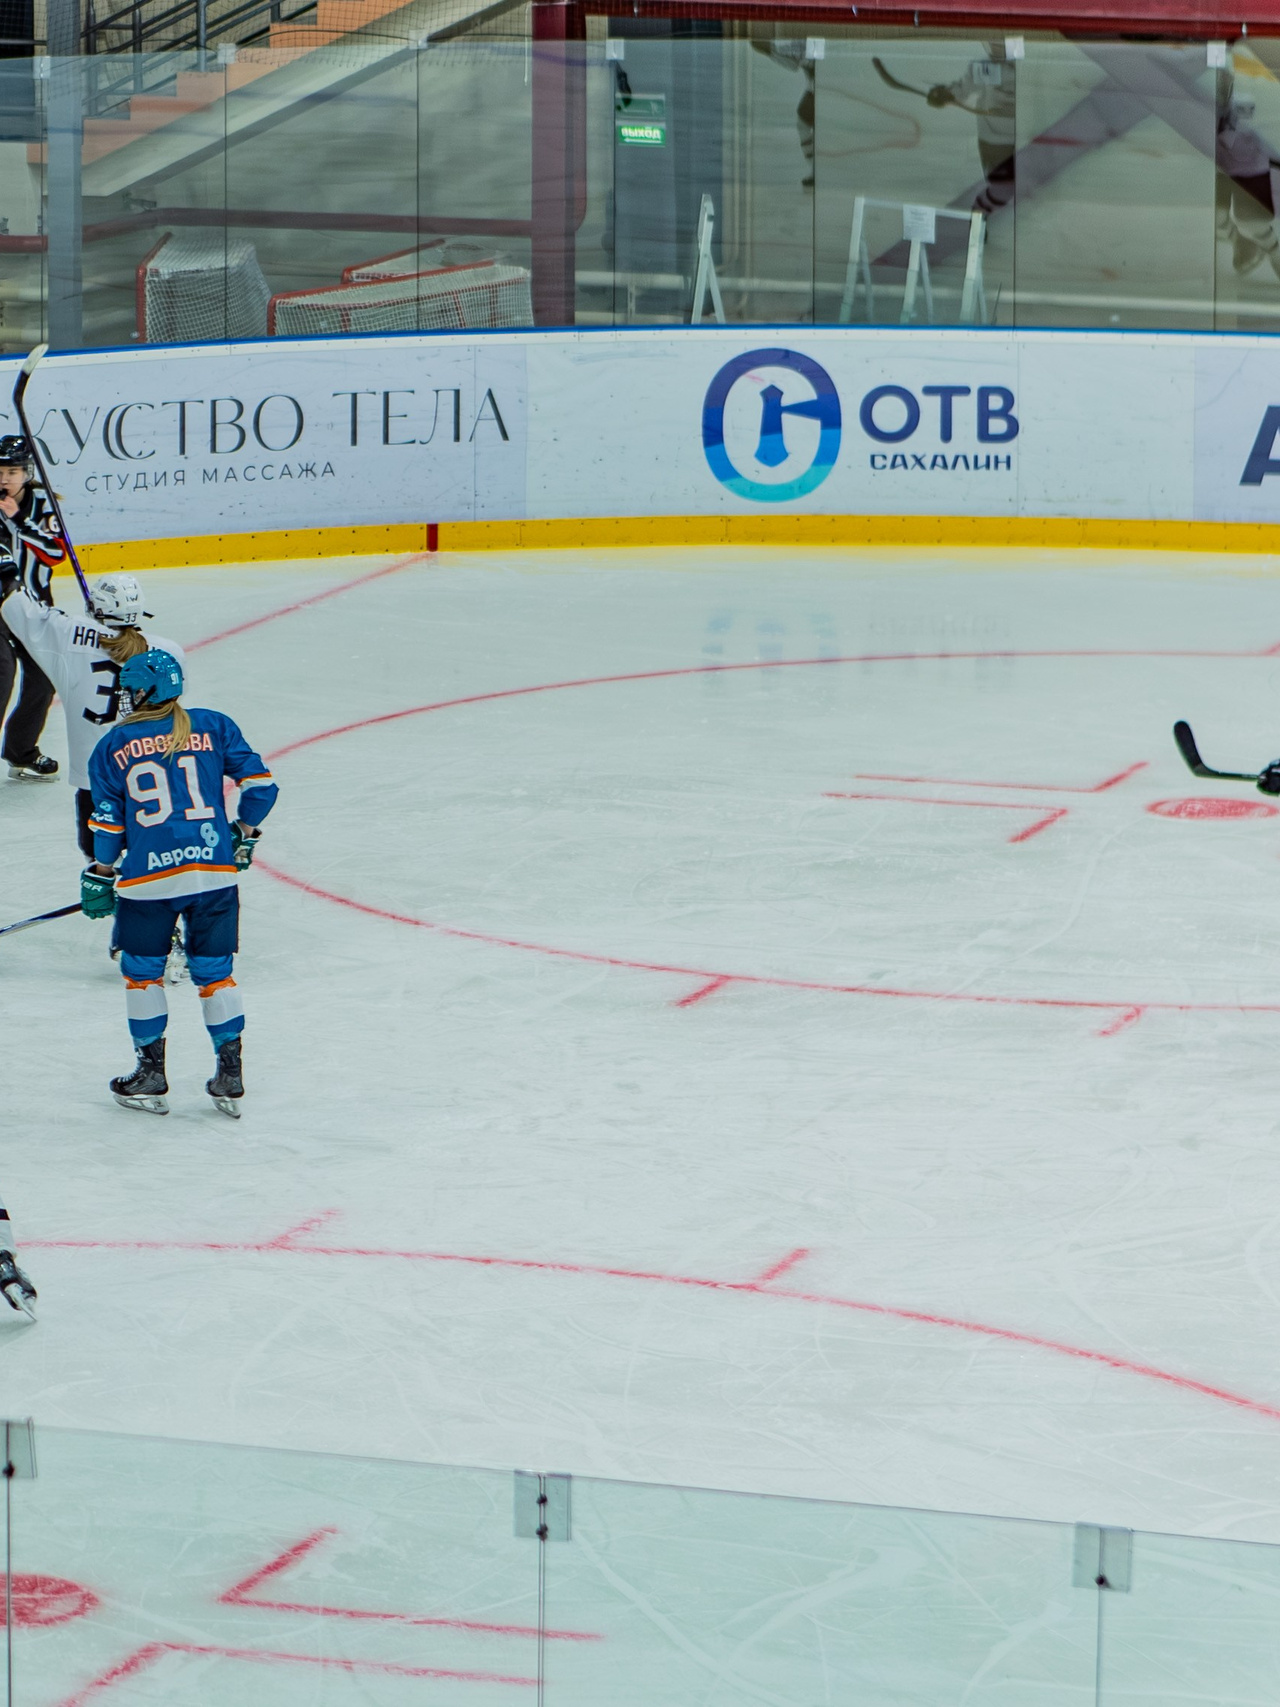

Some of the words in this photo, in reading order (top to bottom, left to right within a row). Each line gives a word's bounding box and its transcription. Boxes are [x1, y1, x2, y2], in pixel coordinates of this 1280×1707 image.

[332, 388, 510, 447] ТЕЛА
[859, 385, 1020, 444] ОТВ
[84, 469, 186, 493] СТУДИЯ
[202, 461, 336, 485] МАССАЖА
[870, 453, 1011, 471] САХАЛИН
[124, 612, 138, 624] 33
[125, 754, 216, 828] 91
[147, 845, 214, 871] Аврора
